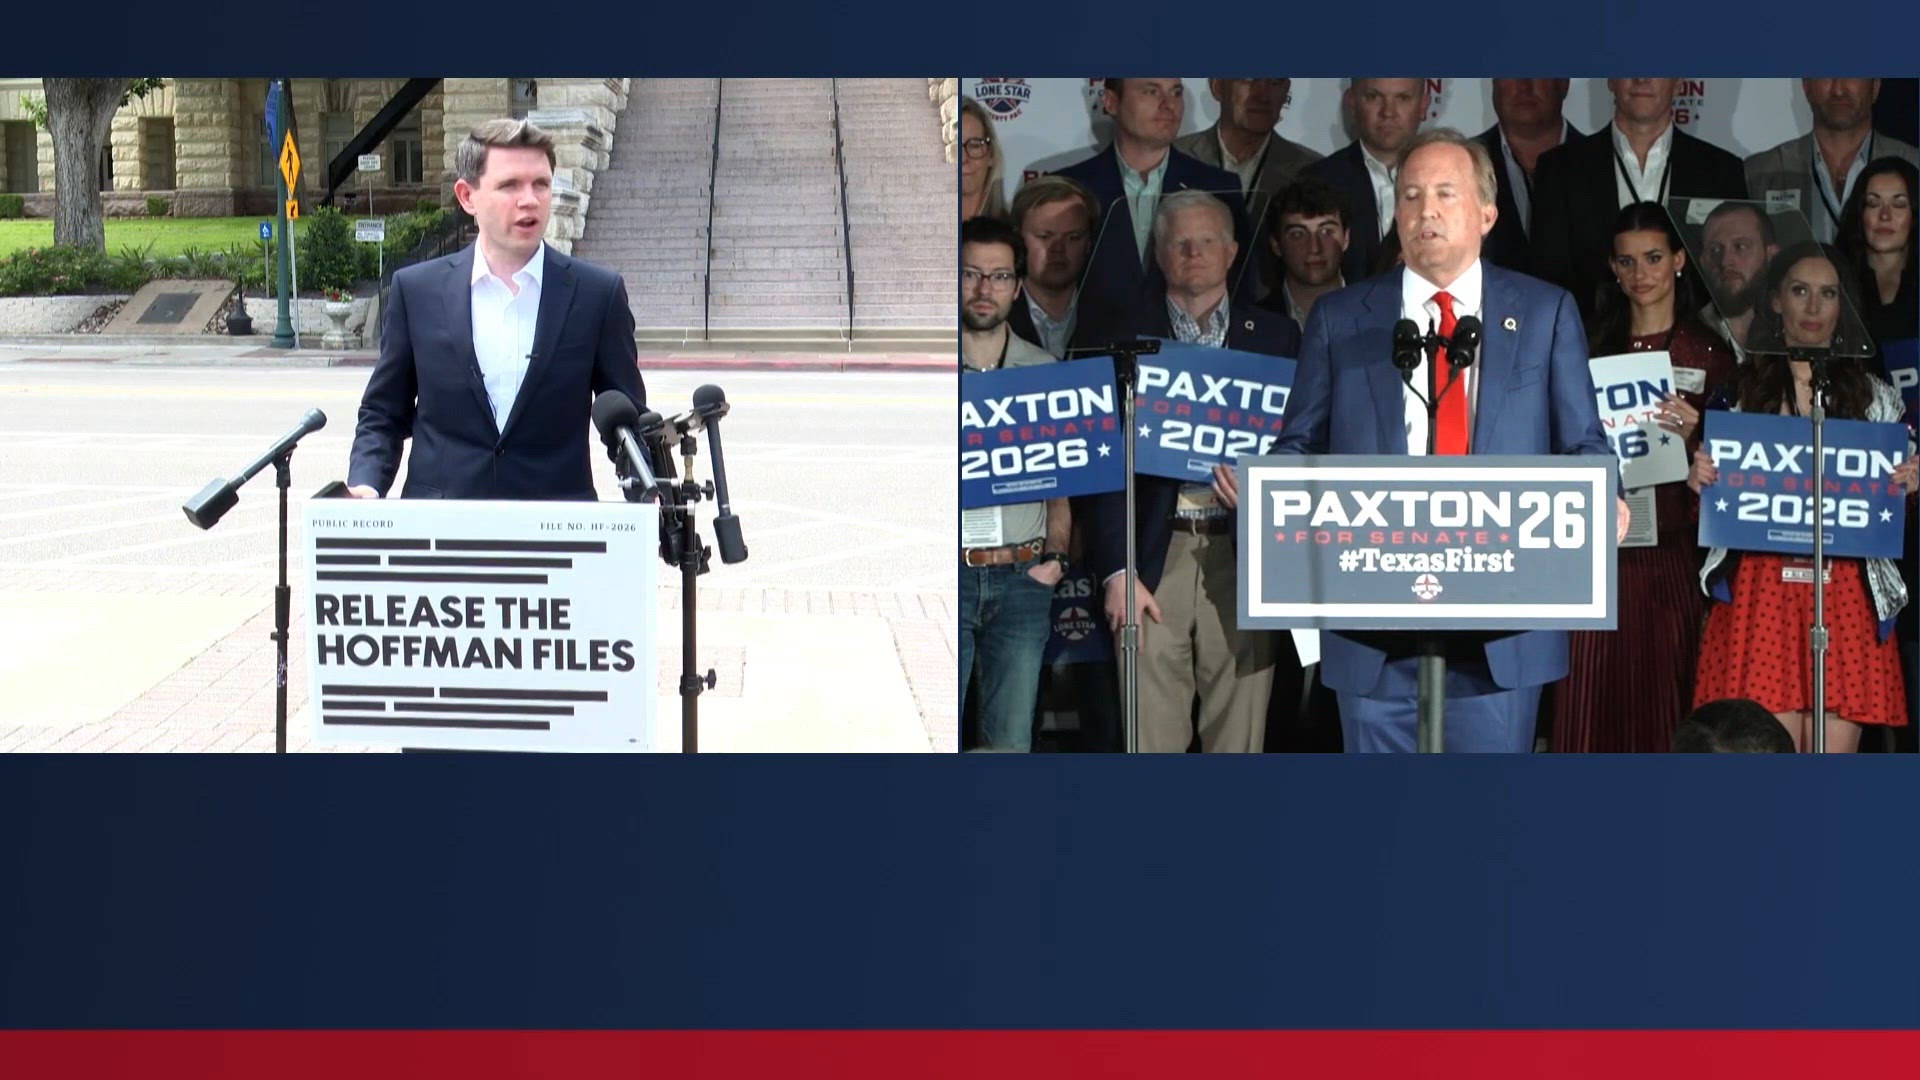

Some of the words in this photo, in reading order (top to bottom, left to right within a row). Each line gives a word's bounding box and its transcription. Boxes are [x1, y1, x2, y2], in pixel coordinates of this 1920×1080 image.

[975, 85, 1002, 97] LONE
[1004, 85, 1031, 99] STAR
[1137, 364, 1292, 415] PAXTO
[999, 417, 1117, 444] SENATE
[962, 438, 1089, 481] 2026
[1709, 438, 1903, 479] PAXTON
[1783, 476, 1902, 497] SENATE
[312, 519, 348, 528] PUBLIC
[353, 519, 394, 529] RECORD
[1269, 490, 1512, 528] PAXTON
[1518, 491, 1586, 549] 26
[1737, 492, 1870, 529] 2026
[540, 522, 562, 531] FILE
[567, 522, 586, 531] NO.
[591, 522, 636, 532] HF-2026
[1295, 531, 1353, 545] FOR
[1370, 531, 1490, 545] SENATE
[1339, 547, 1515, 573] #TexasFirst
[315, 593, 486, 629] RELEASE
[495, 596, 571, 631] THE
[317, 633, 523, 670] HOFFMAN
[533, 638, 636, 673] FILES
